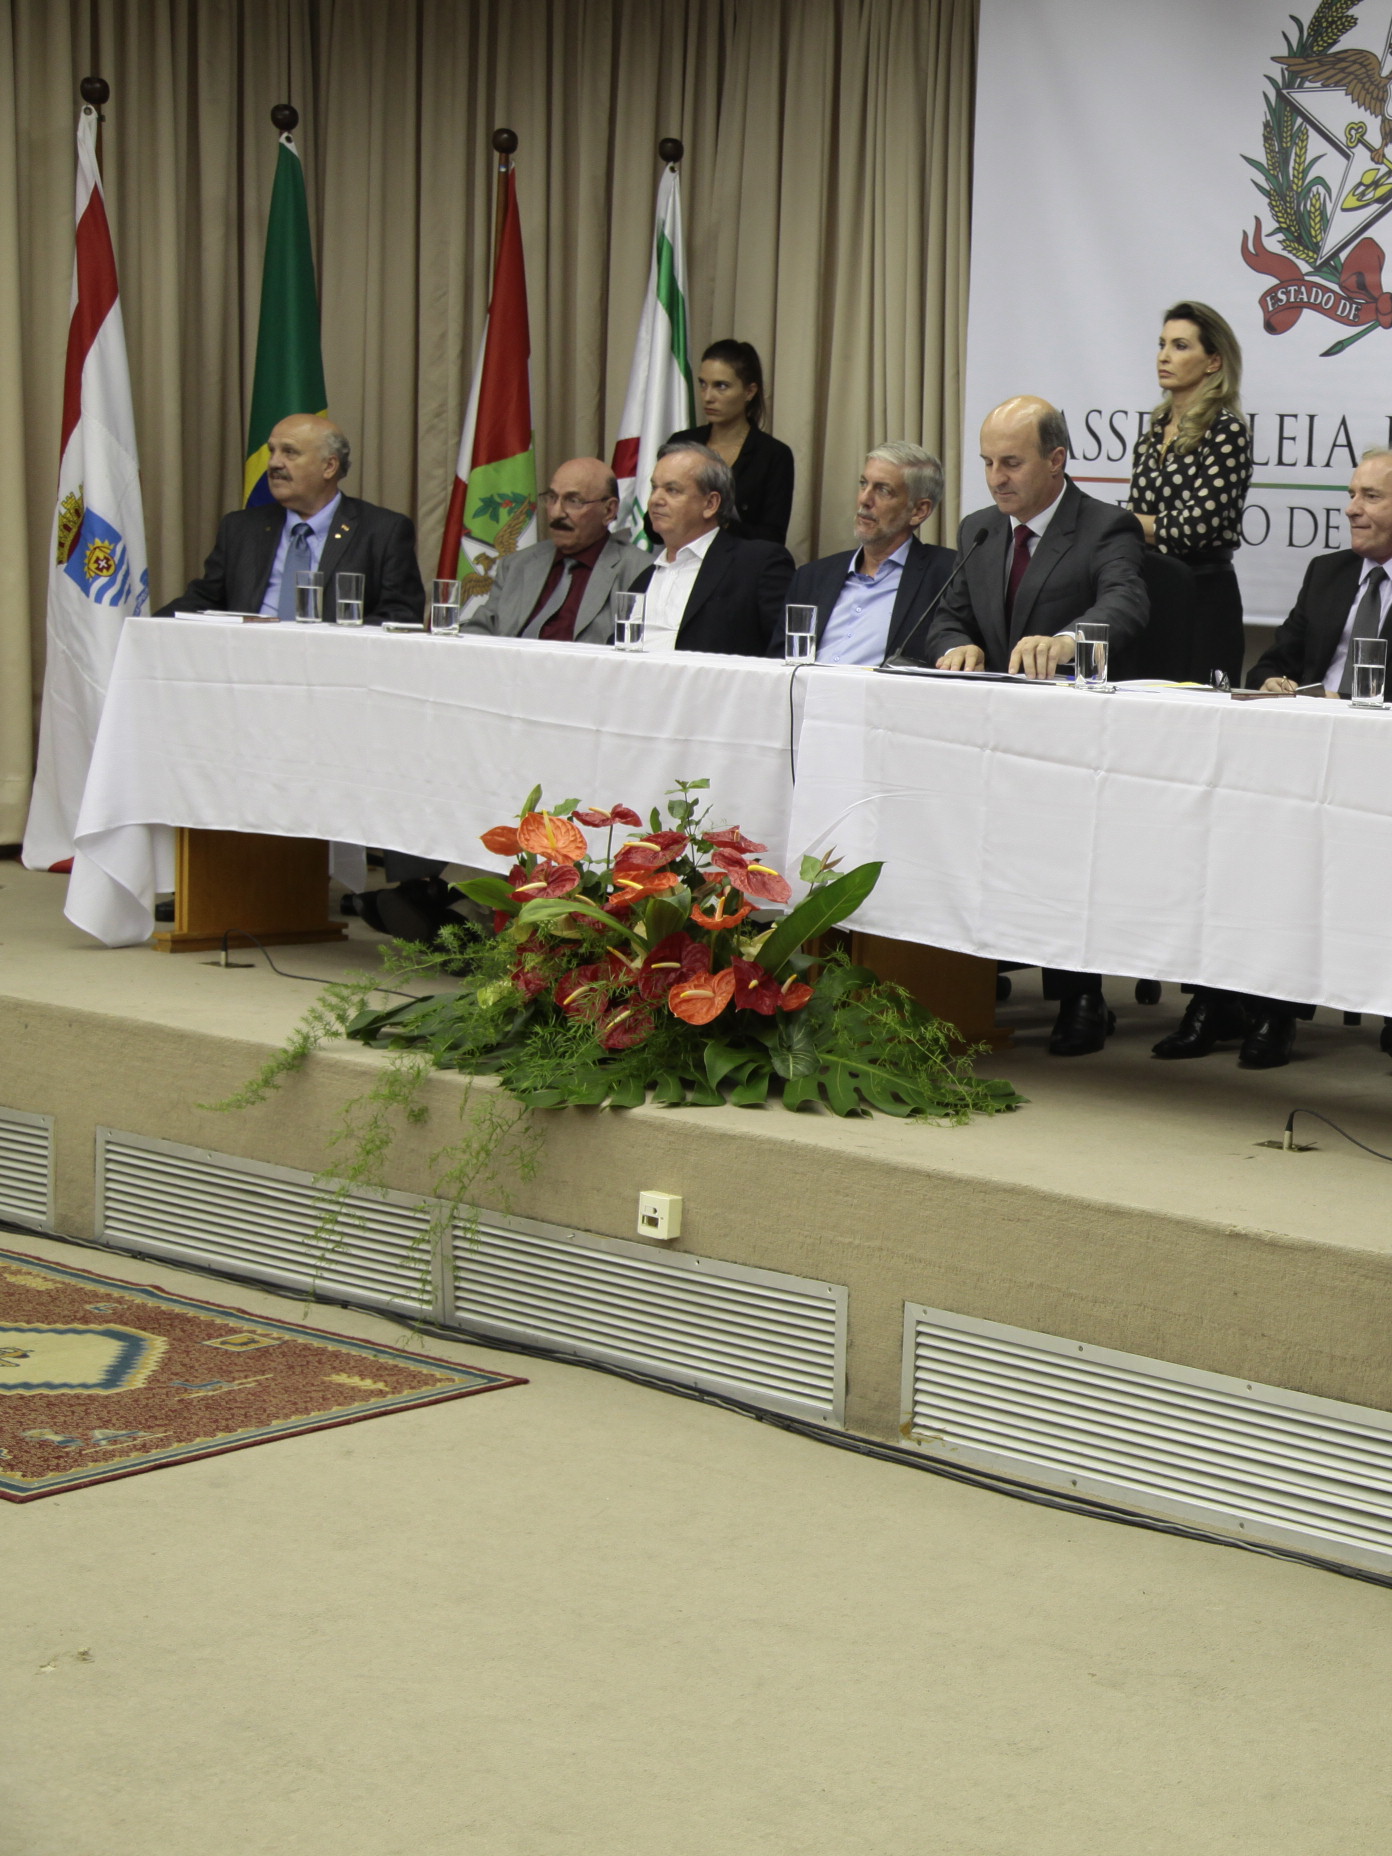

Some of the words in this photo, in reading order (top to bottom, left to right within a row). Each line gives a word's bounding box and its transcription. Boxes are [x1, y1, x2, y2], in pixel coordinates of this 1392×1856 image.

[1265, 285, 1335, 312] ESTADO
[1336, 303, 1361, 321] DE
[1061, 408, 1358, 469] ASSLEIA
[1286, 506, 1342, 549] DE
